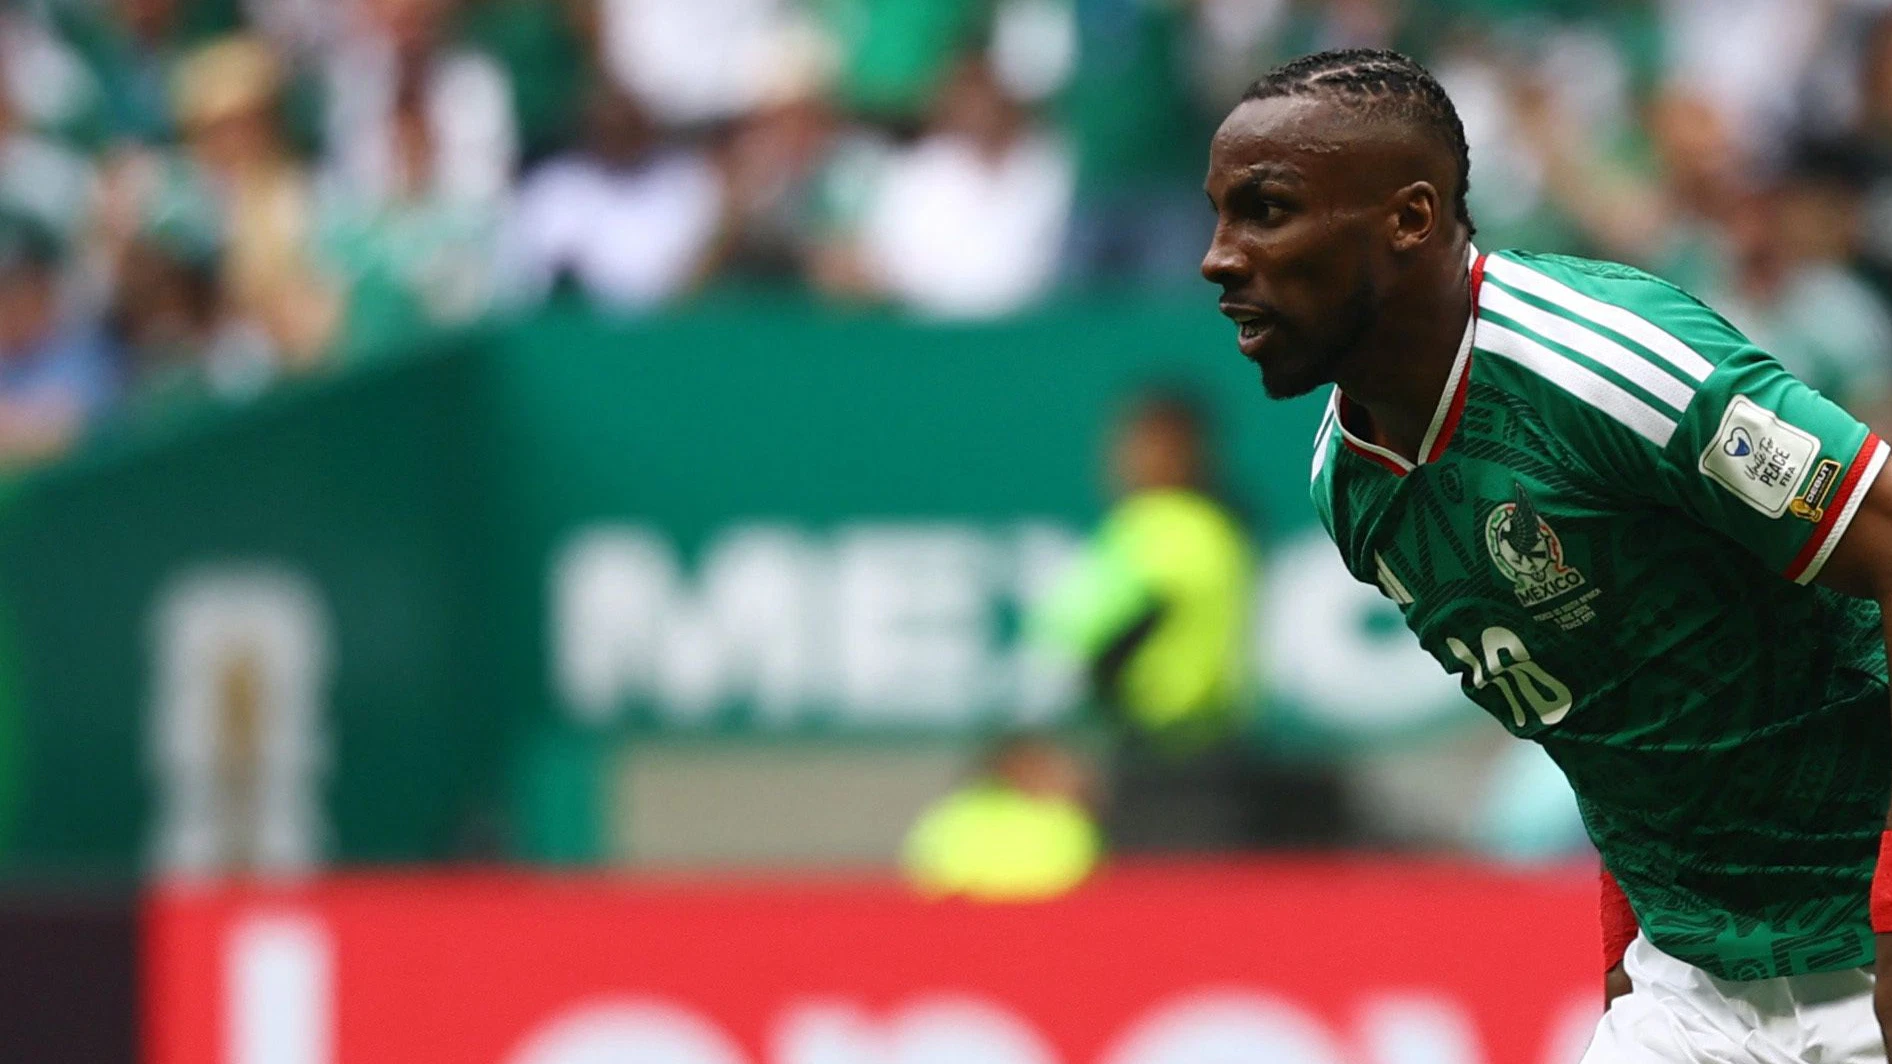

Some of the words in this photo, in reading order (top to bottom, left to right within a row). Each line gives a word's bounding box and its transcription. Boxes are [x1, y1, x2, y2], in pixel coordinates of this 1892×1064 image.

[1760, 447, 1790, 487] PEACE
[1779, 465, 1796, 487] FIFA
[1806, 464, 1831, 504] DEBUT
